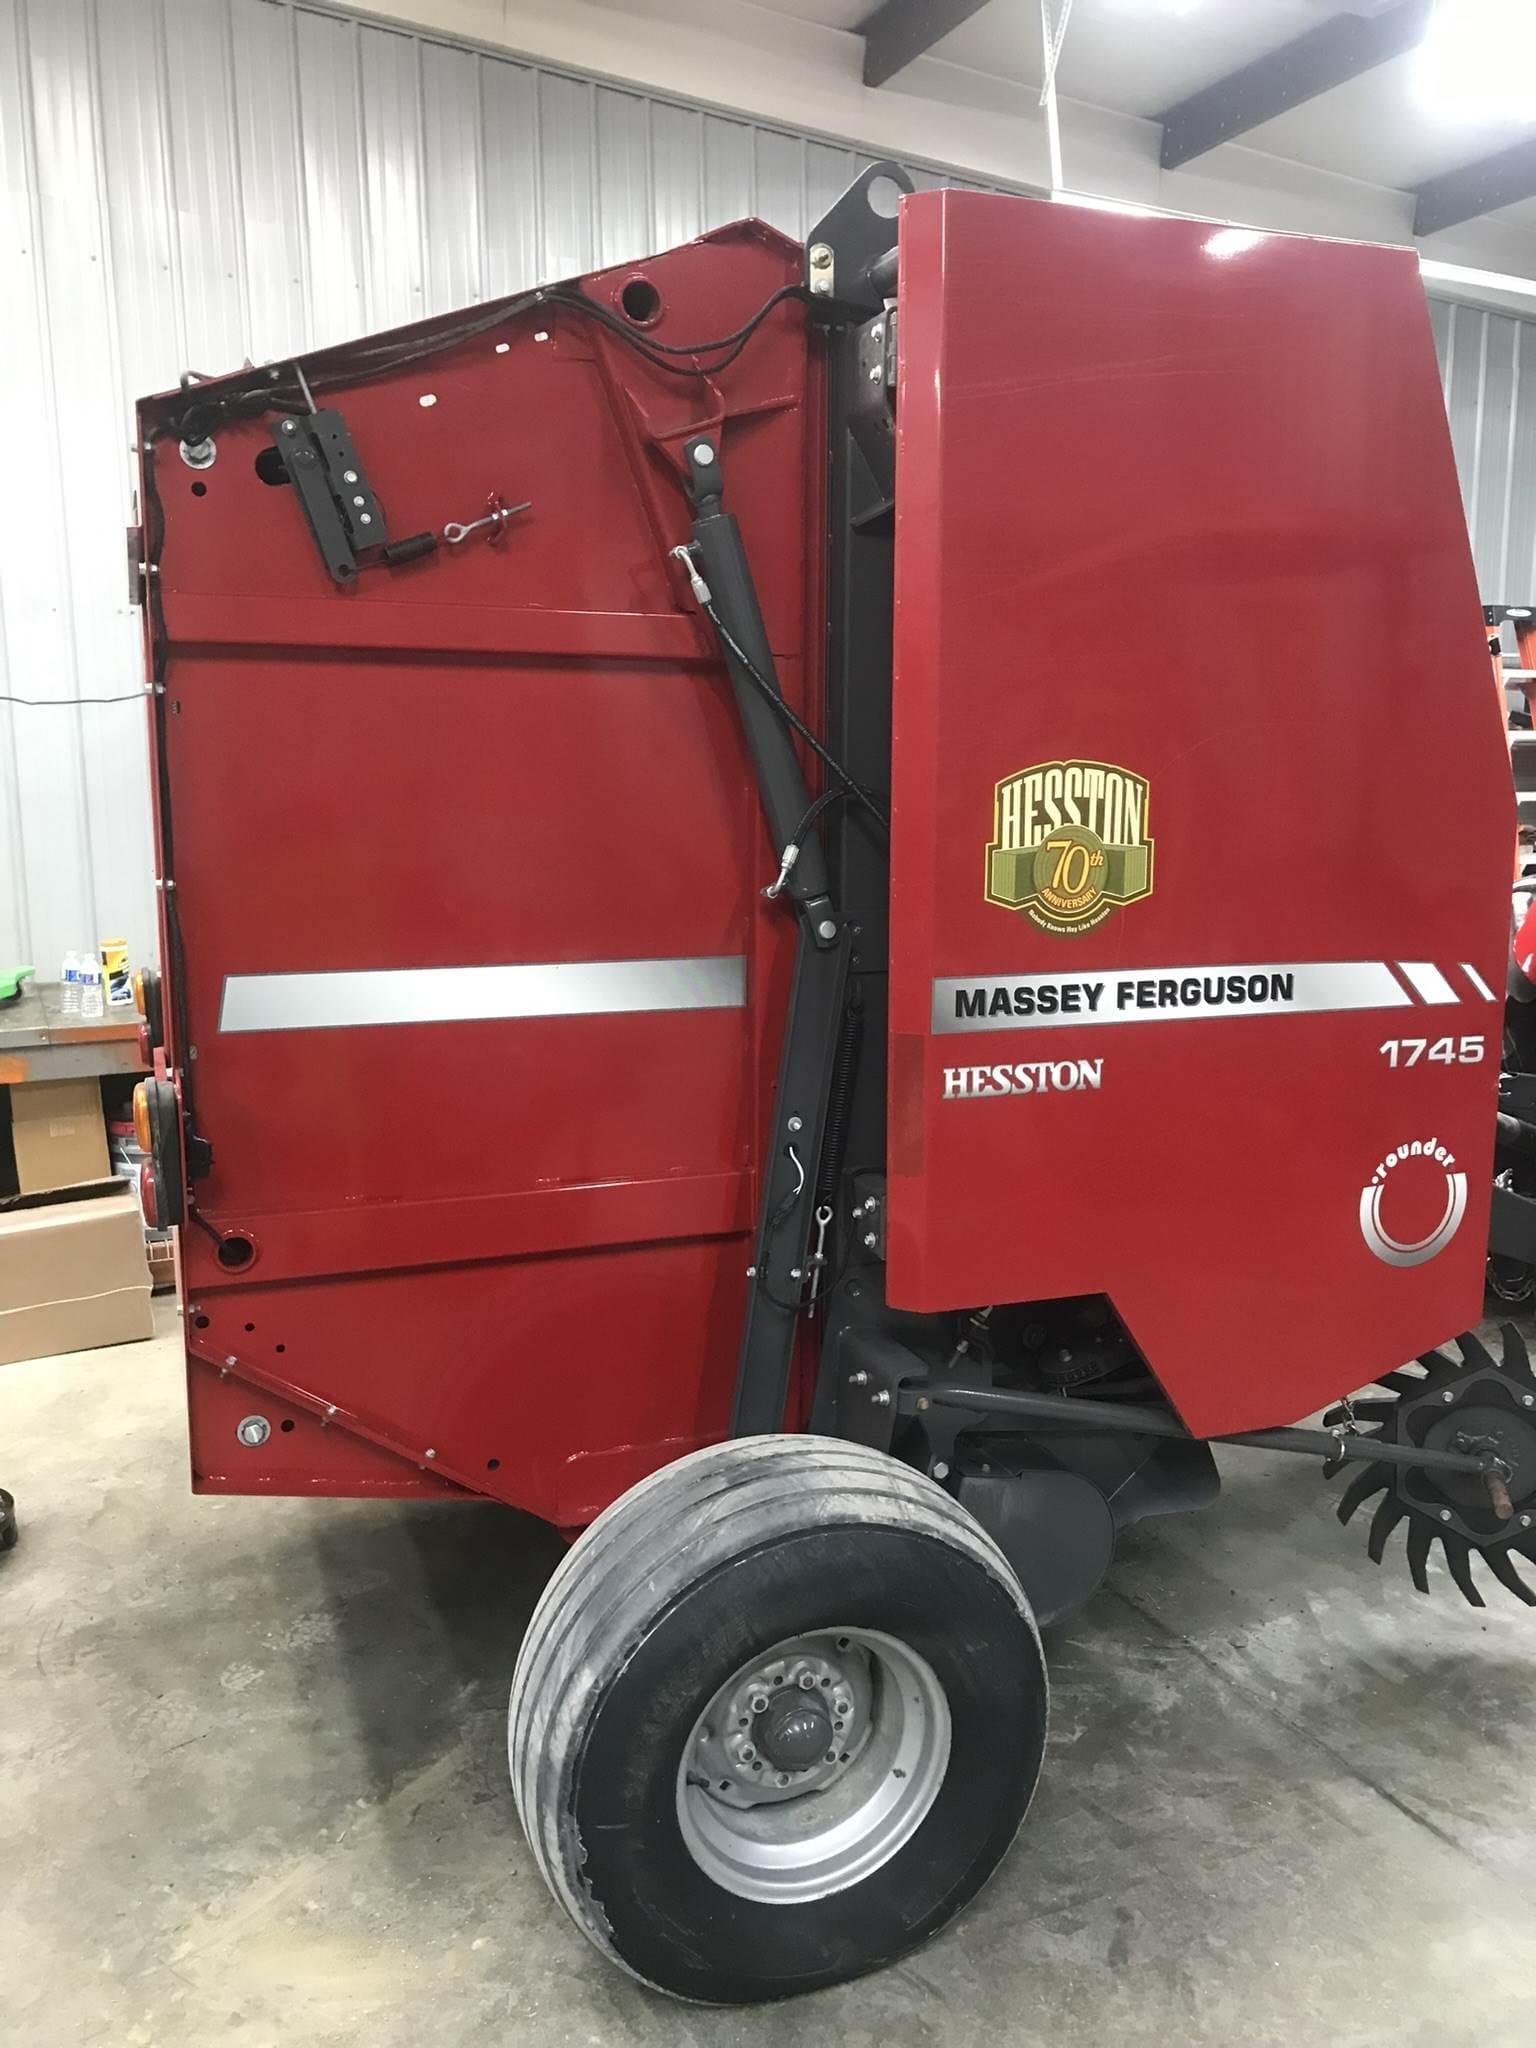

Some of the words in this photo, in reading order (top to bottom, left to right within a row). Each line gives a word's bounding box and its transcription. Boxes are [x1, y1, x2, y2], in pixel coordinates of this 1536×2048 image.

[1001, 767, 1143, 850] HESSTON
[1041, 887, 1097, 909] ANNIVERSARY
[955, 982, 1104, 1018] MASSEY
[1116, 973, 1294, 1010] FERGUSON
[1379, 1036, 1485, 1068] 1745
[942, 1059, 1104, 1100] HESSTON
